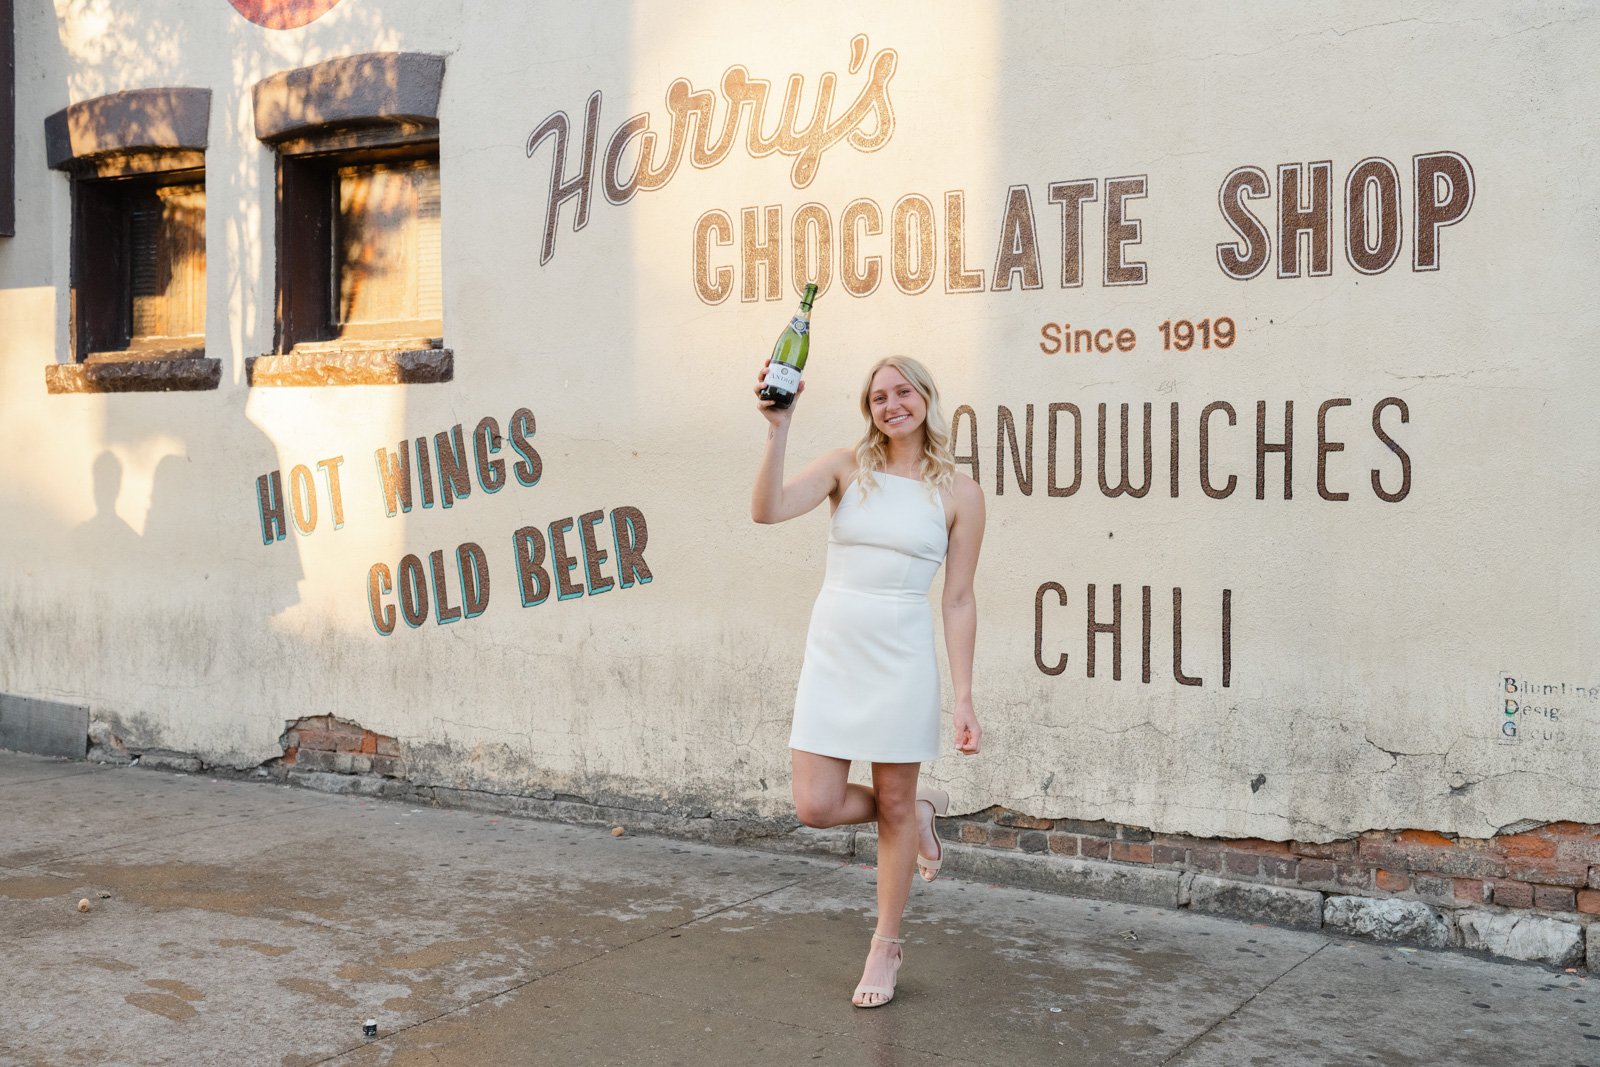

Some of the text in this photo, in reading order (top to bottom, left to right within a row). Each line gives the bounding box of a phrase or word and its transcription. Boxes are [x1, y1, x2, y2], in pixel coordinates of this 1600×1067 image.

[526, 33, 898, 266] Harry's
[693, 150, 1475, 306] CHOCOLATE SHOP
[1039, 316, 1237, 355] Since 1919
[255, 407, 543, 546] HOT WINGS
[950, 397, 1412, 503] ANDWICHES
[366, 505, 653, 637] COLD BEER
[1034, 581, 1232, 688] CHILI
